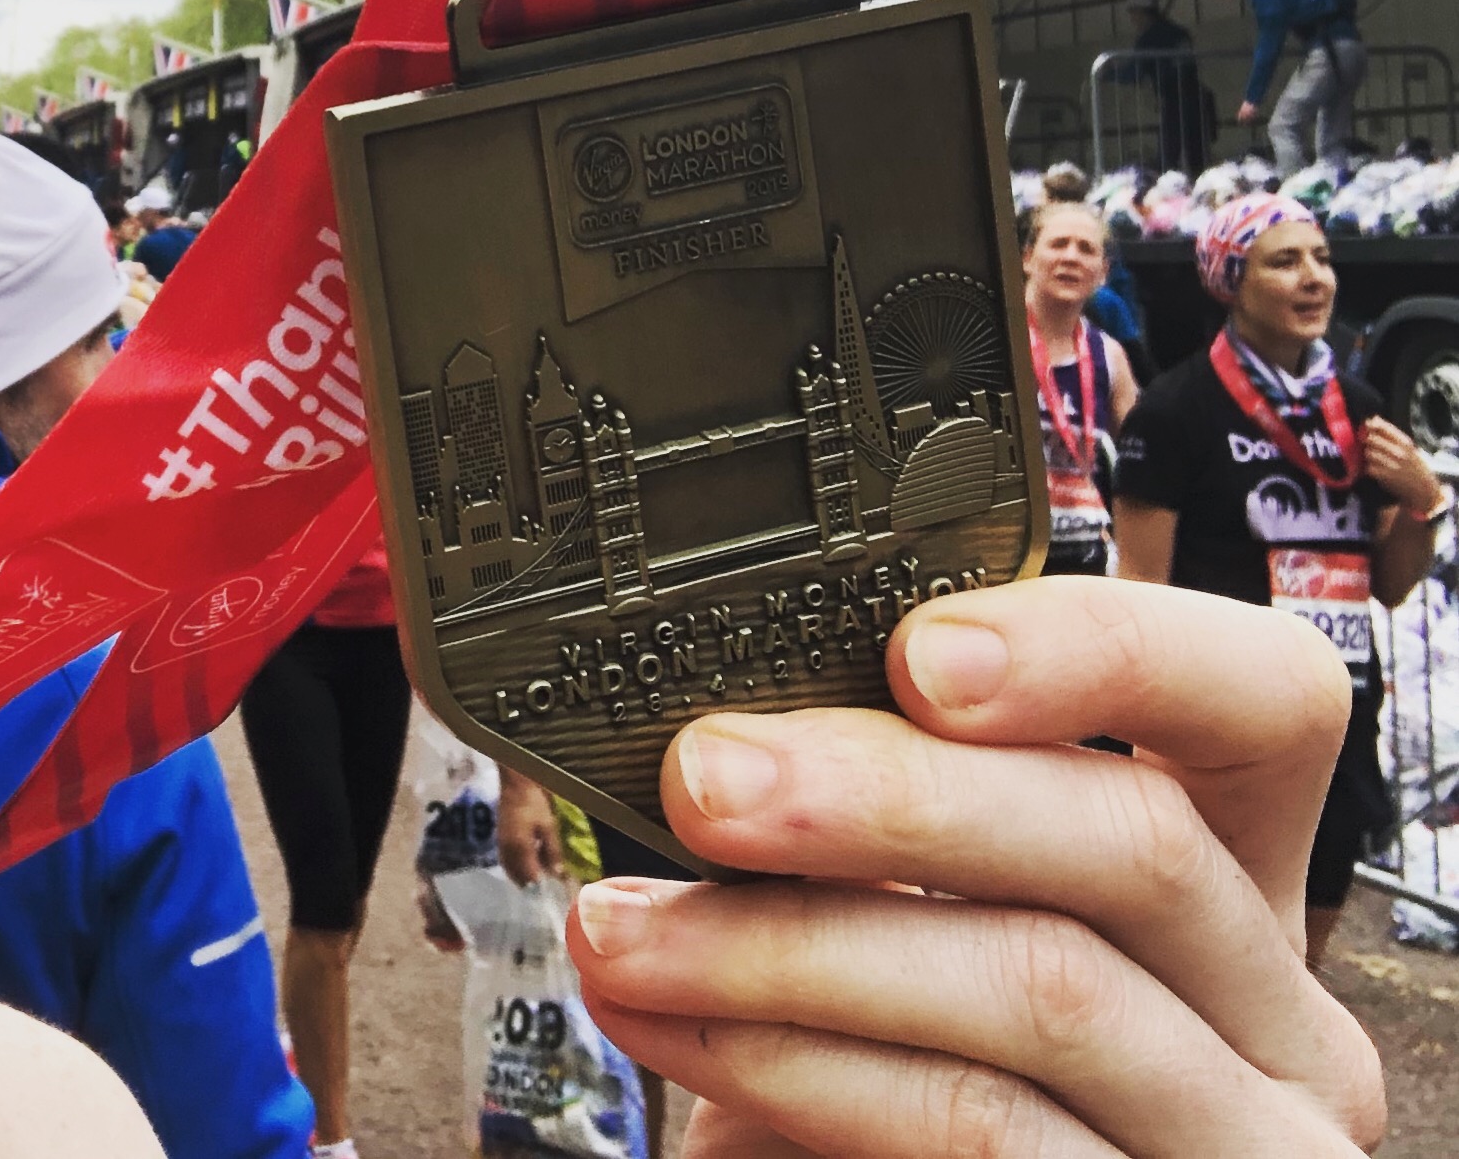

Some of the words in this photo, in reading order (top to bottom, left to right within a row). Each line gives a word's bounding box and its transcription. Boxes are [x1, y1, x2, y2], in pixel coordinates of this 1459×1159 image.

[642, 120, 748, 162] LONDON
[646, 141, 786, 189] MARATHON
[746, 173, 790, 200] 2019
[581, 206, 640, 230] money
[614, 221, 771, 276] FINISHER
[248, 566, 307, 625] money
[560, 604, 732, 669] VIRGIN
[764, 556, 919, 618] MONEY
[495, 643, 698, 723] LONDON
